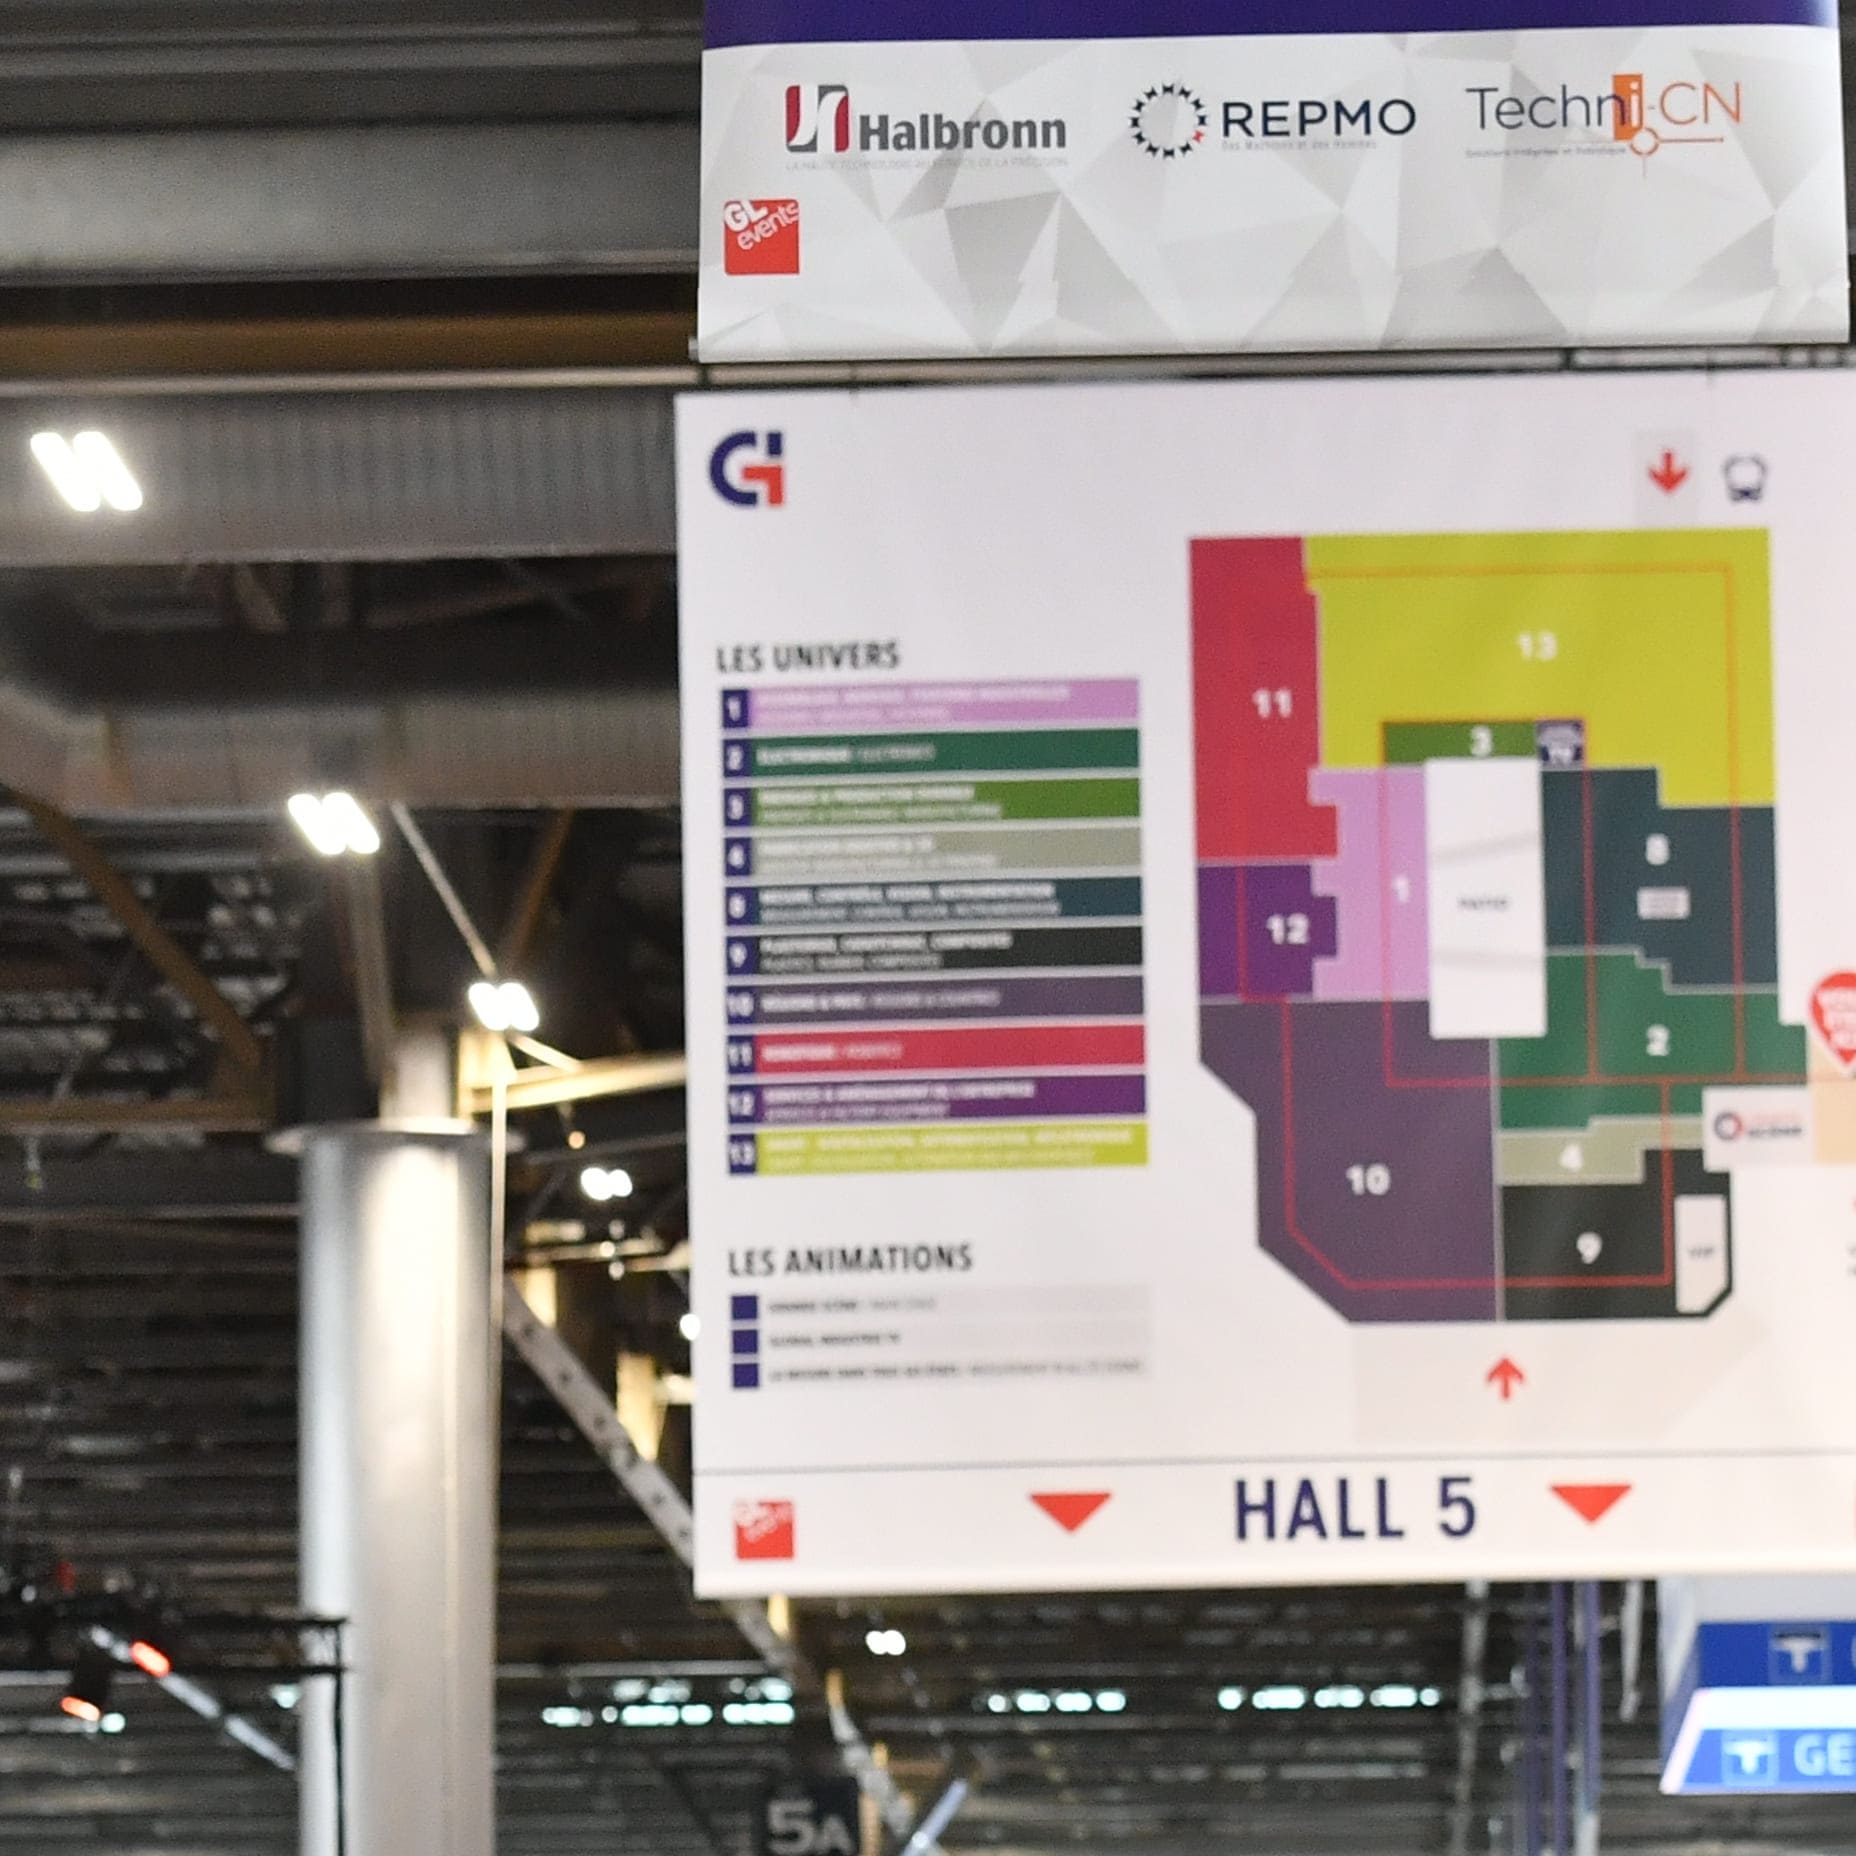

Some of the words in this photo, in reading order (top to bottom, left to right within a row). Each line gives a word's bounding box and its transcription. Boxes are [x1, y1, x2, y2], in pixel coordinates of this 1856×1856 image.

[858, 112, 1068, 152] Halbronn
[1221, 98, 1417, 138] REPMO
[724, 199, 769, 232] GL
[737, 202, 799, 250] events
[716, 643, 763, 673] LES
[773, 640, 901, 672] UNIVERS
[1252, 690, 1293, 718] 11
[1266, 914, 1310, 945] 12
[1346, 1165, 1390, 1196] 10
[727, 1249, 775, 1277] LES
[783, 1243, 974, 1275] ANIMATIONS
[1235, 1477, 1406, 1541] HALL
[1438, 1475, 1478, 1538] 5
